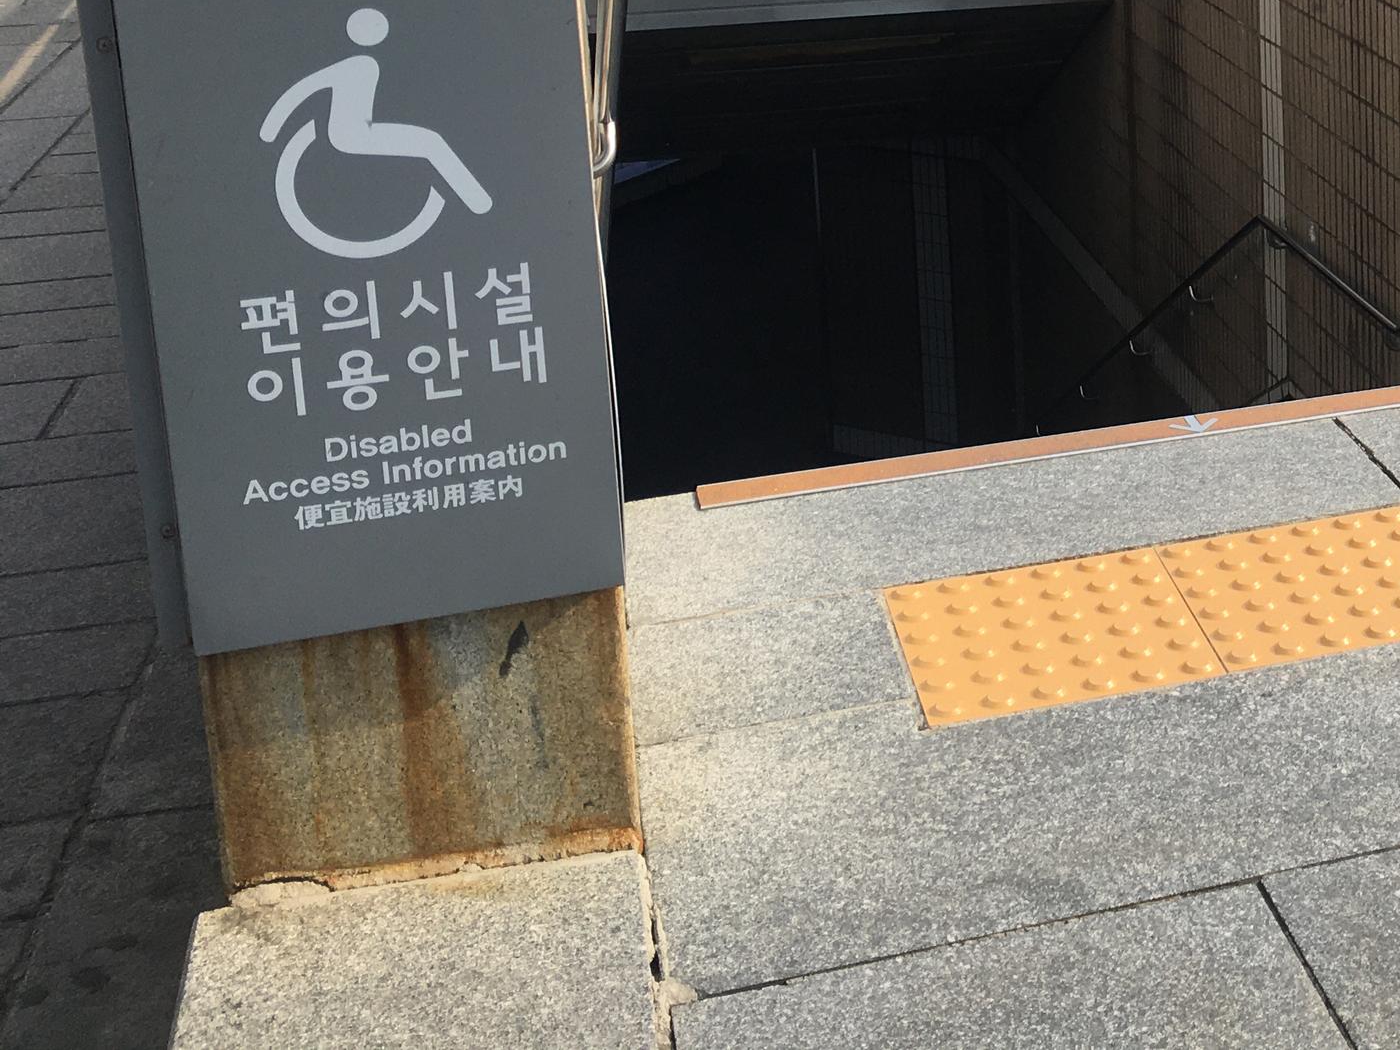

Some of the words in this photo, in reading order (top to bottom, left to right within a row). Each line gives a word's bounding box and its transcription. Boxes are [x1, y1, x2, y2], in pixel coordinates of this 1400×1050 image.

[240, 262, 536, 355] 편의시설
[246, 326, 549, 417] 이용안내
[243, 464, 371, 506] Access
[381, 437, 568, 486] Information
[325, 418, 473, 462] Disabled
[294, 475, 523, 531] 便宜施設利用案内
